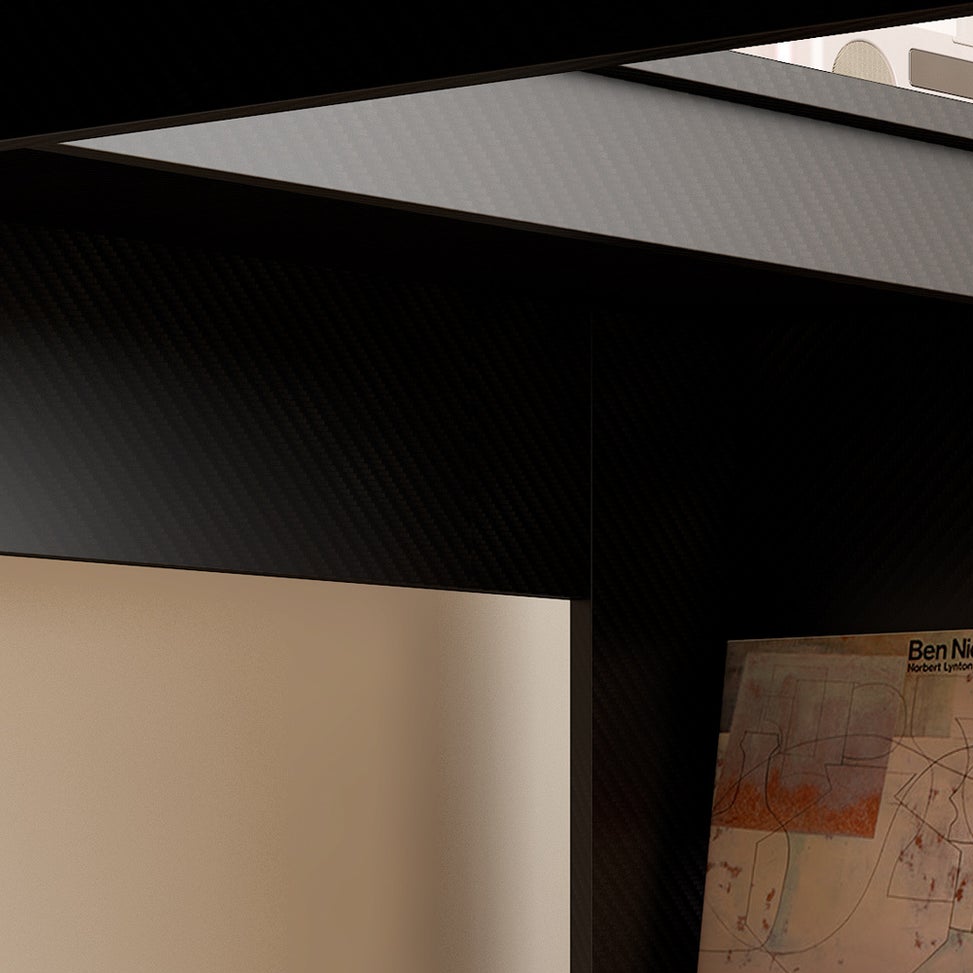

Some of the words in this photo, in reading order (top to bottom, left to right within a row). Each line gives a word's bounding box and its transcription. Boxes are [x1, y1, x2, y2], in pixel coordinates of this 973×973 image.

[908, 640, 947, 660] Ben
[907, 663, 941, 673] Norbert
[944, 662, 973, 673] Lynton
